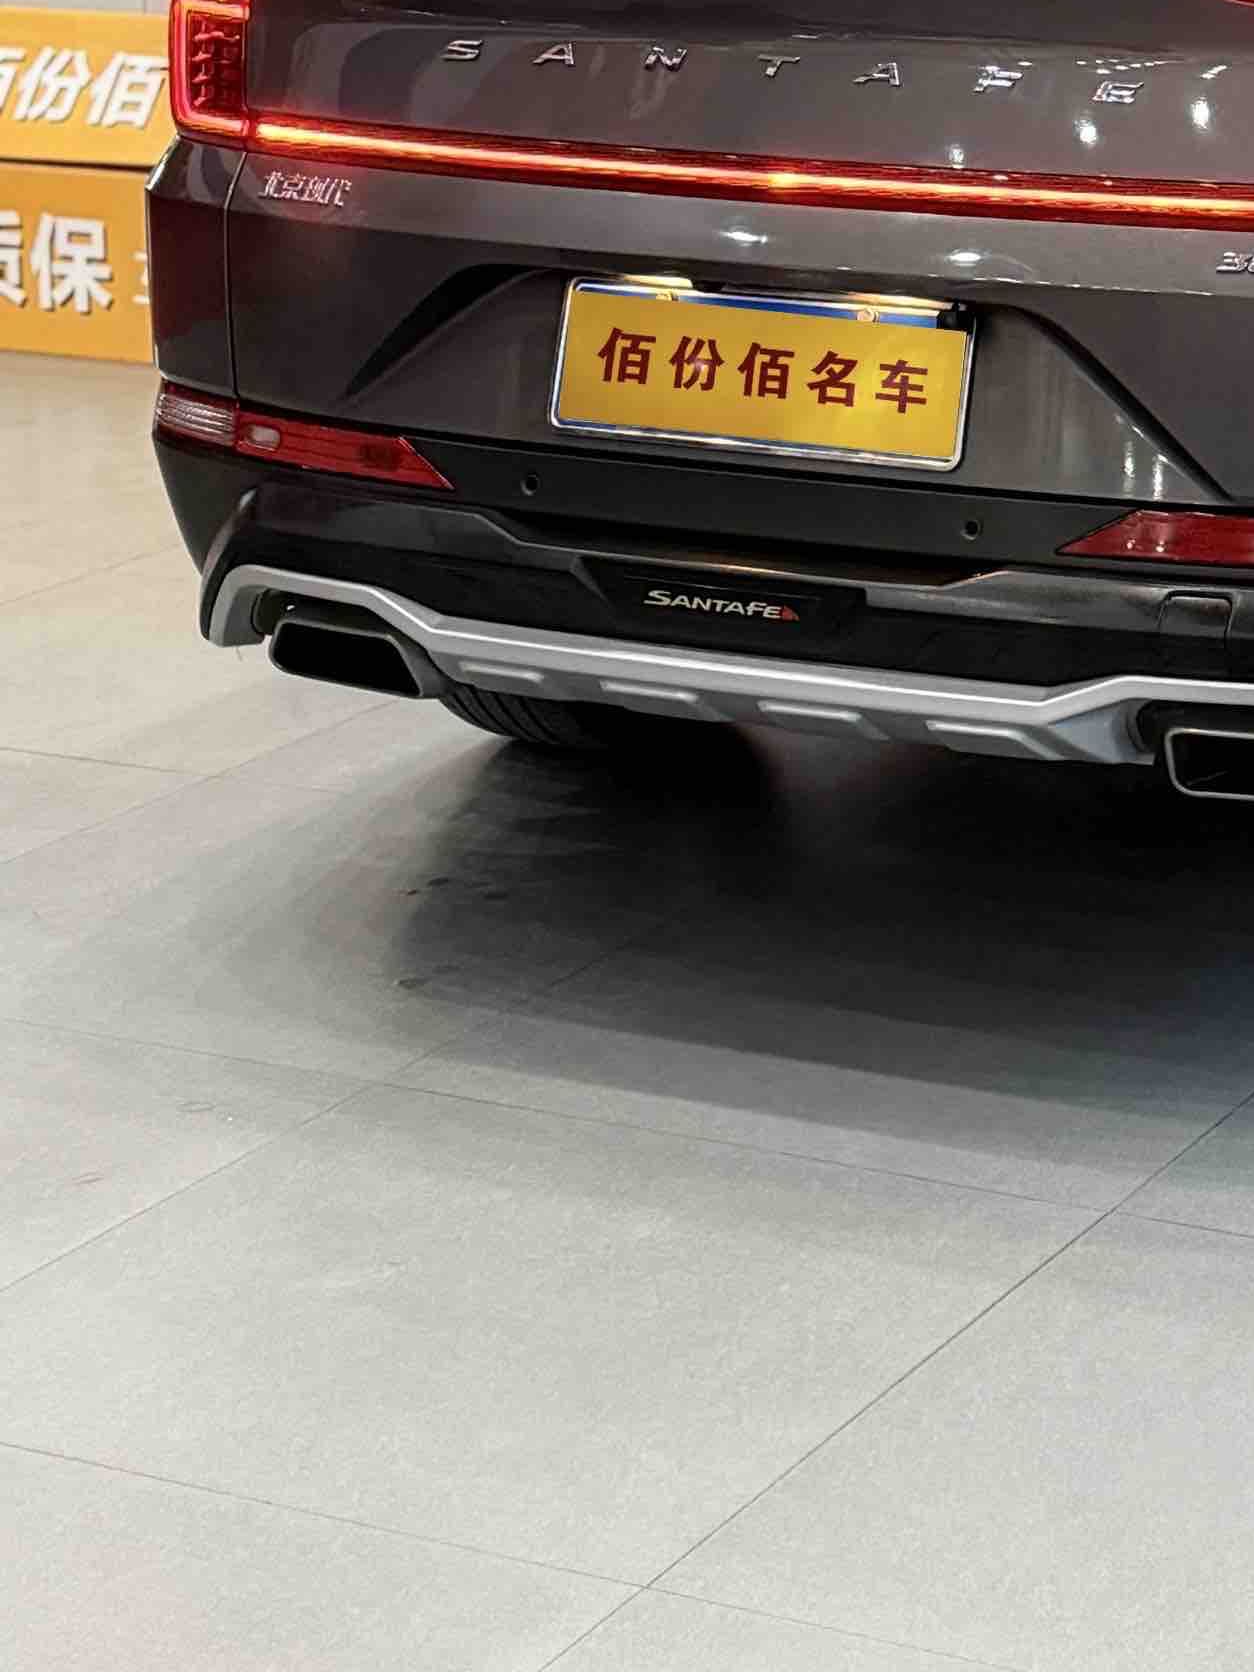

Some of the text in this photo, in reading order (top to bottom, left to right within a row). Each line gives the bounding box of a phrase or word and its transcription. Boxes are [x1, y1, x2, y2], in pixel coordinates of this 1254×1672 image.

[258, 171, 352, 207] 北京现代
[598, 328, 929, 414] 佰份佰名车
